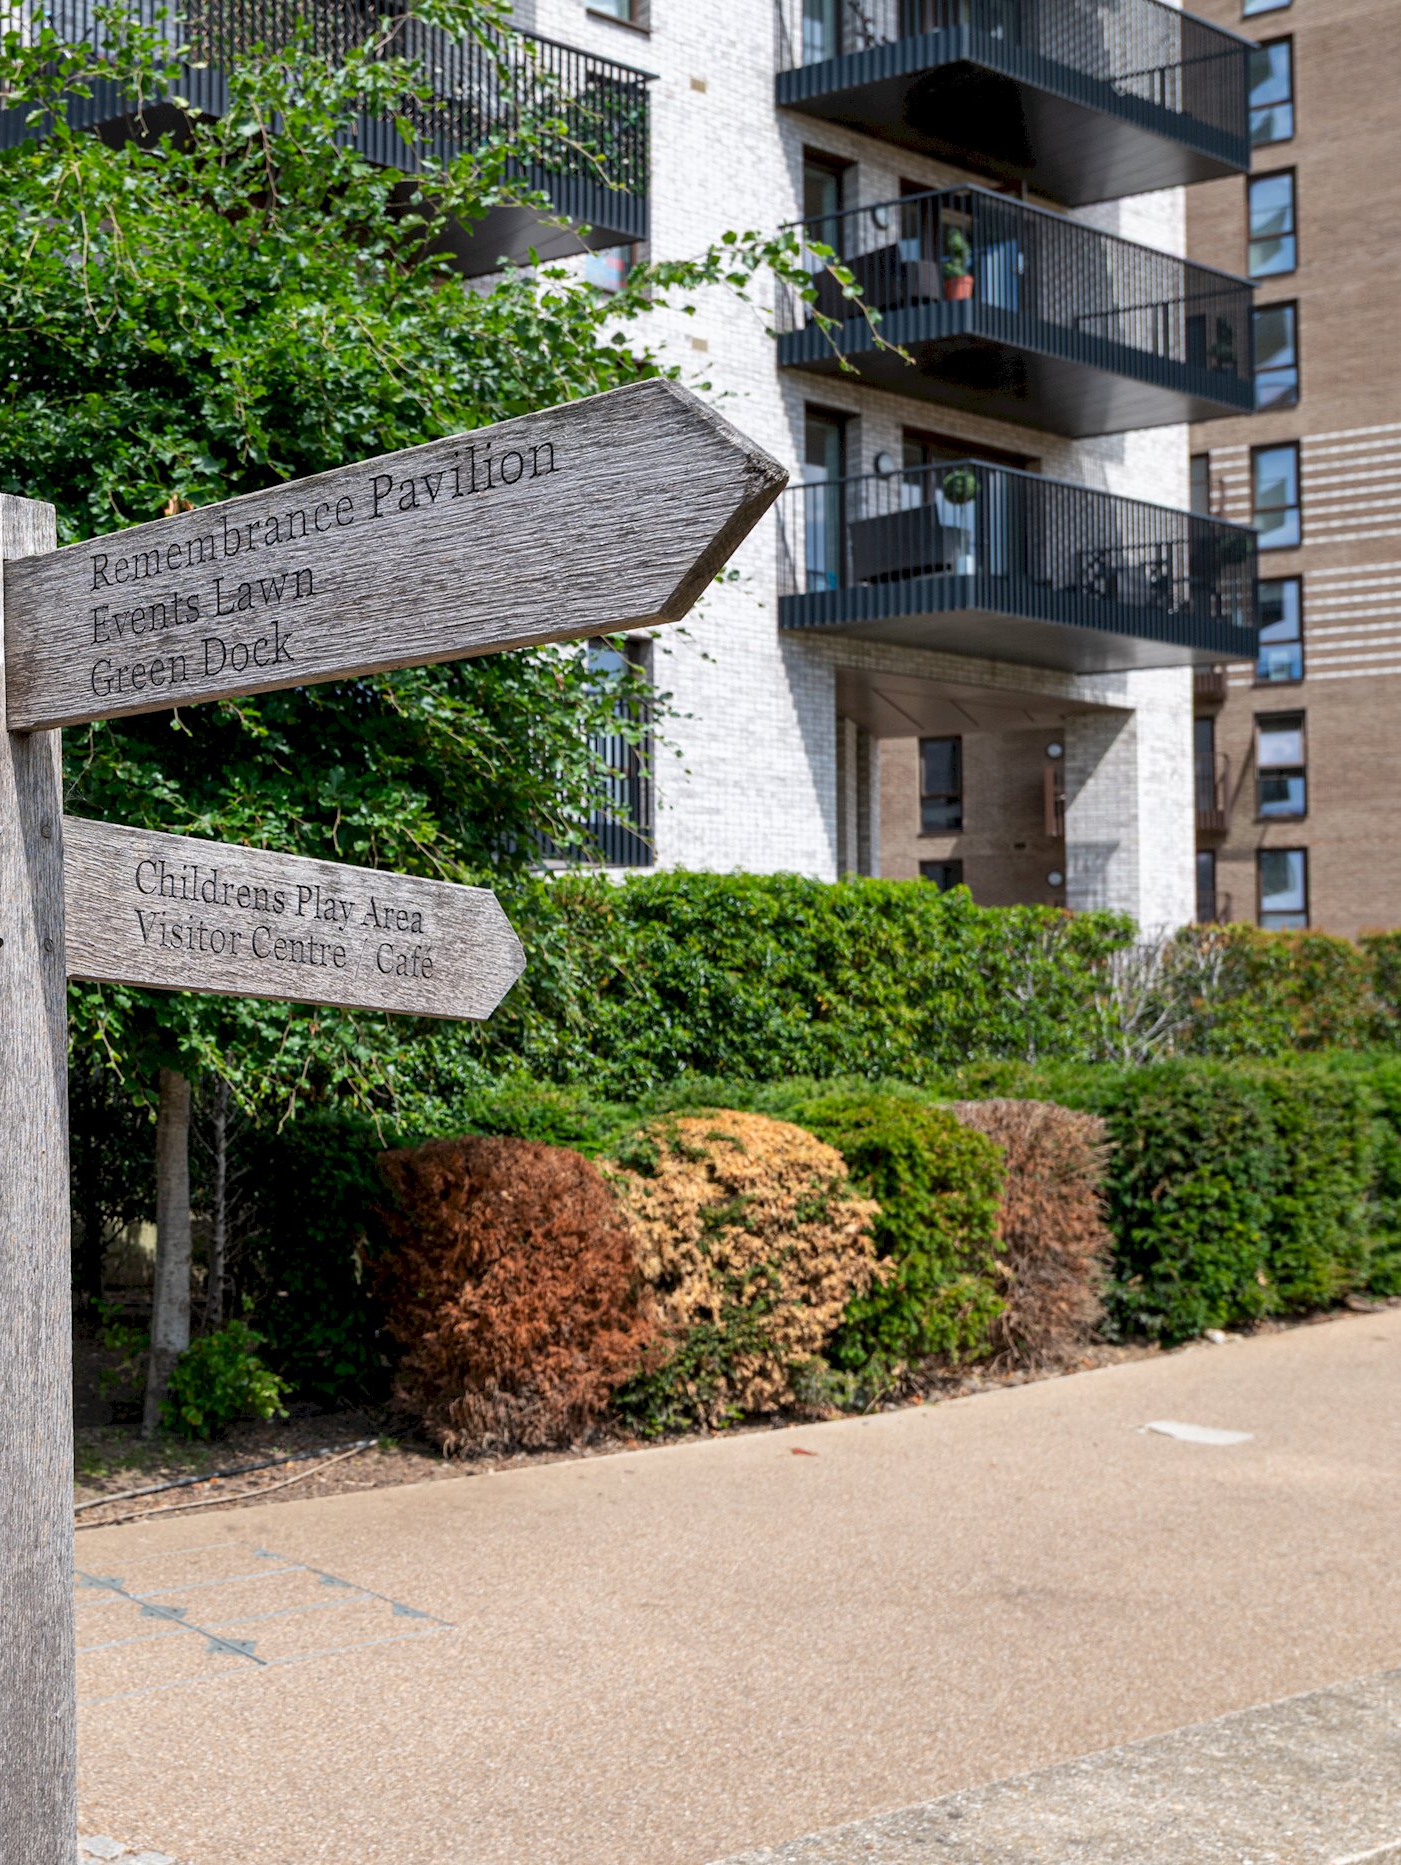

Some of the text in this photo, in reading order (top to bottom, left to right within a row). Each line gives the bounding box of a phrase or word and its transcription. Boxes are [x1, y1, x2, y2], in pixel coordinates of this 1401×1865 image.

[89, 440, 559, 592] Remembrance Pavilion
[90, 568, 317, 646] Events Lawn
[89, 622, 296, 699] Green Dock
[135, 860, 424, 934] Childrens Play Area
[134, 909, 242, 955] Visitor
[252, 925, 347, 969] Centre
[376, 942, 434, 981] Café
